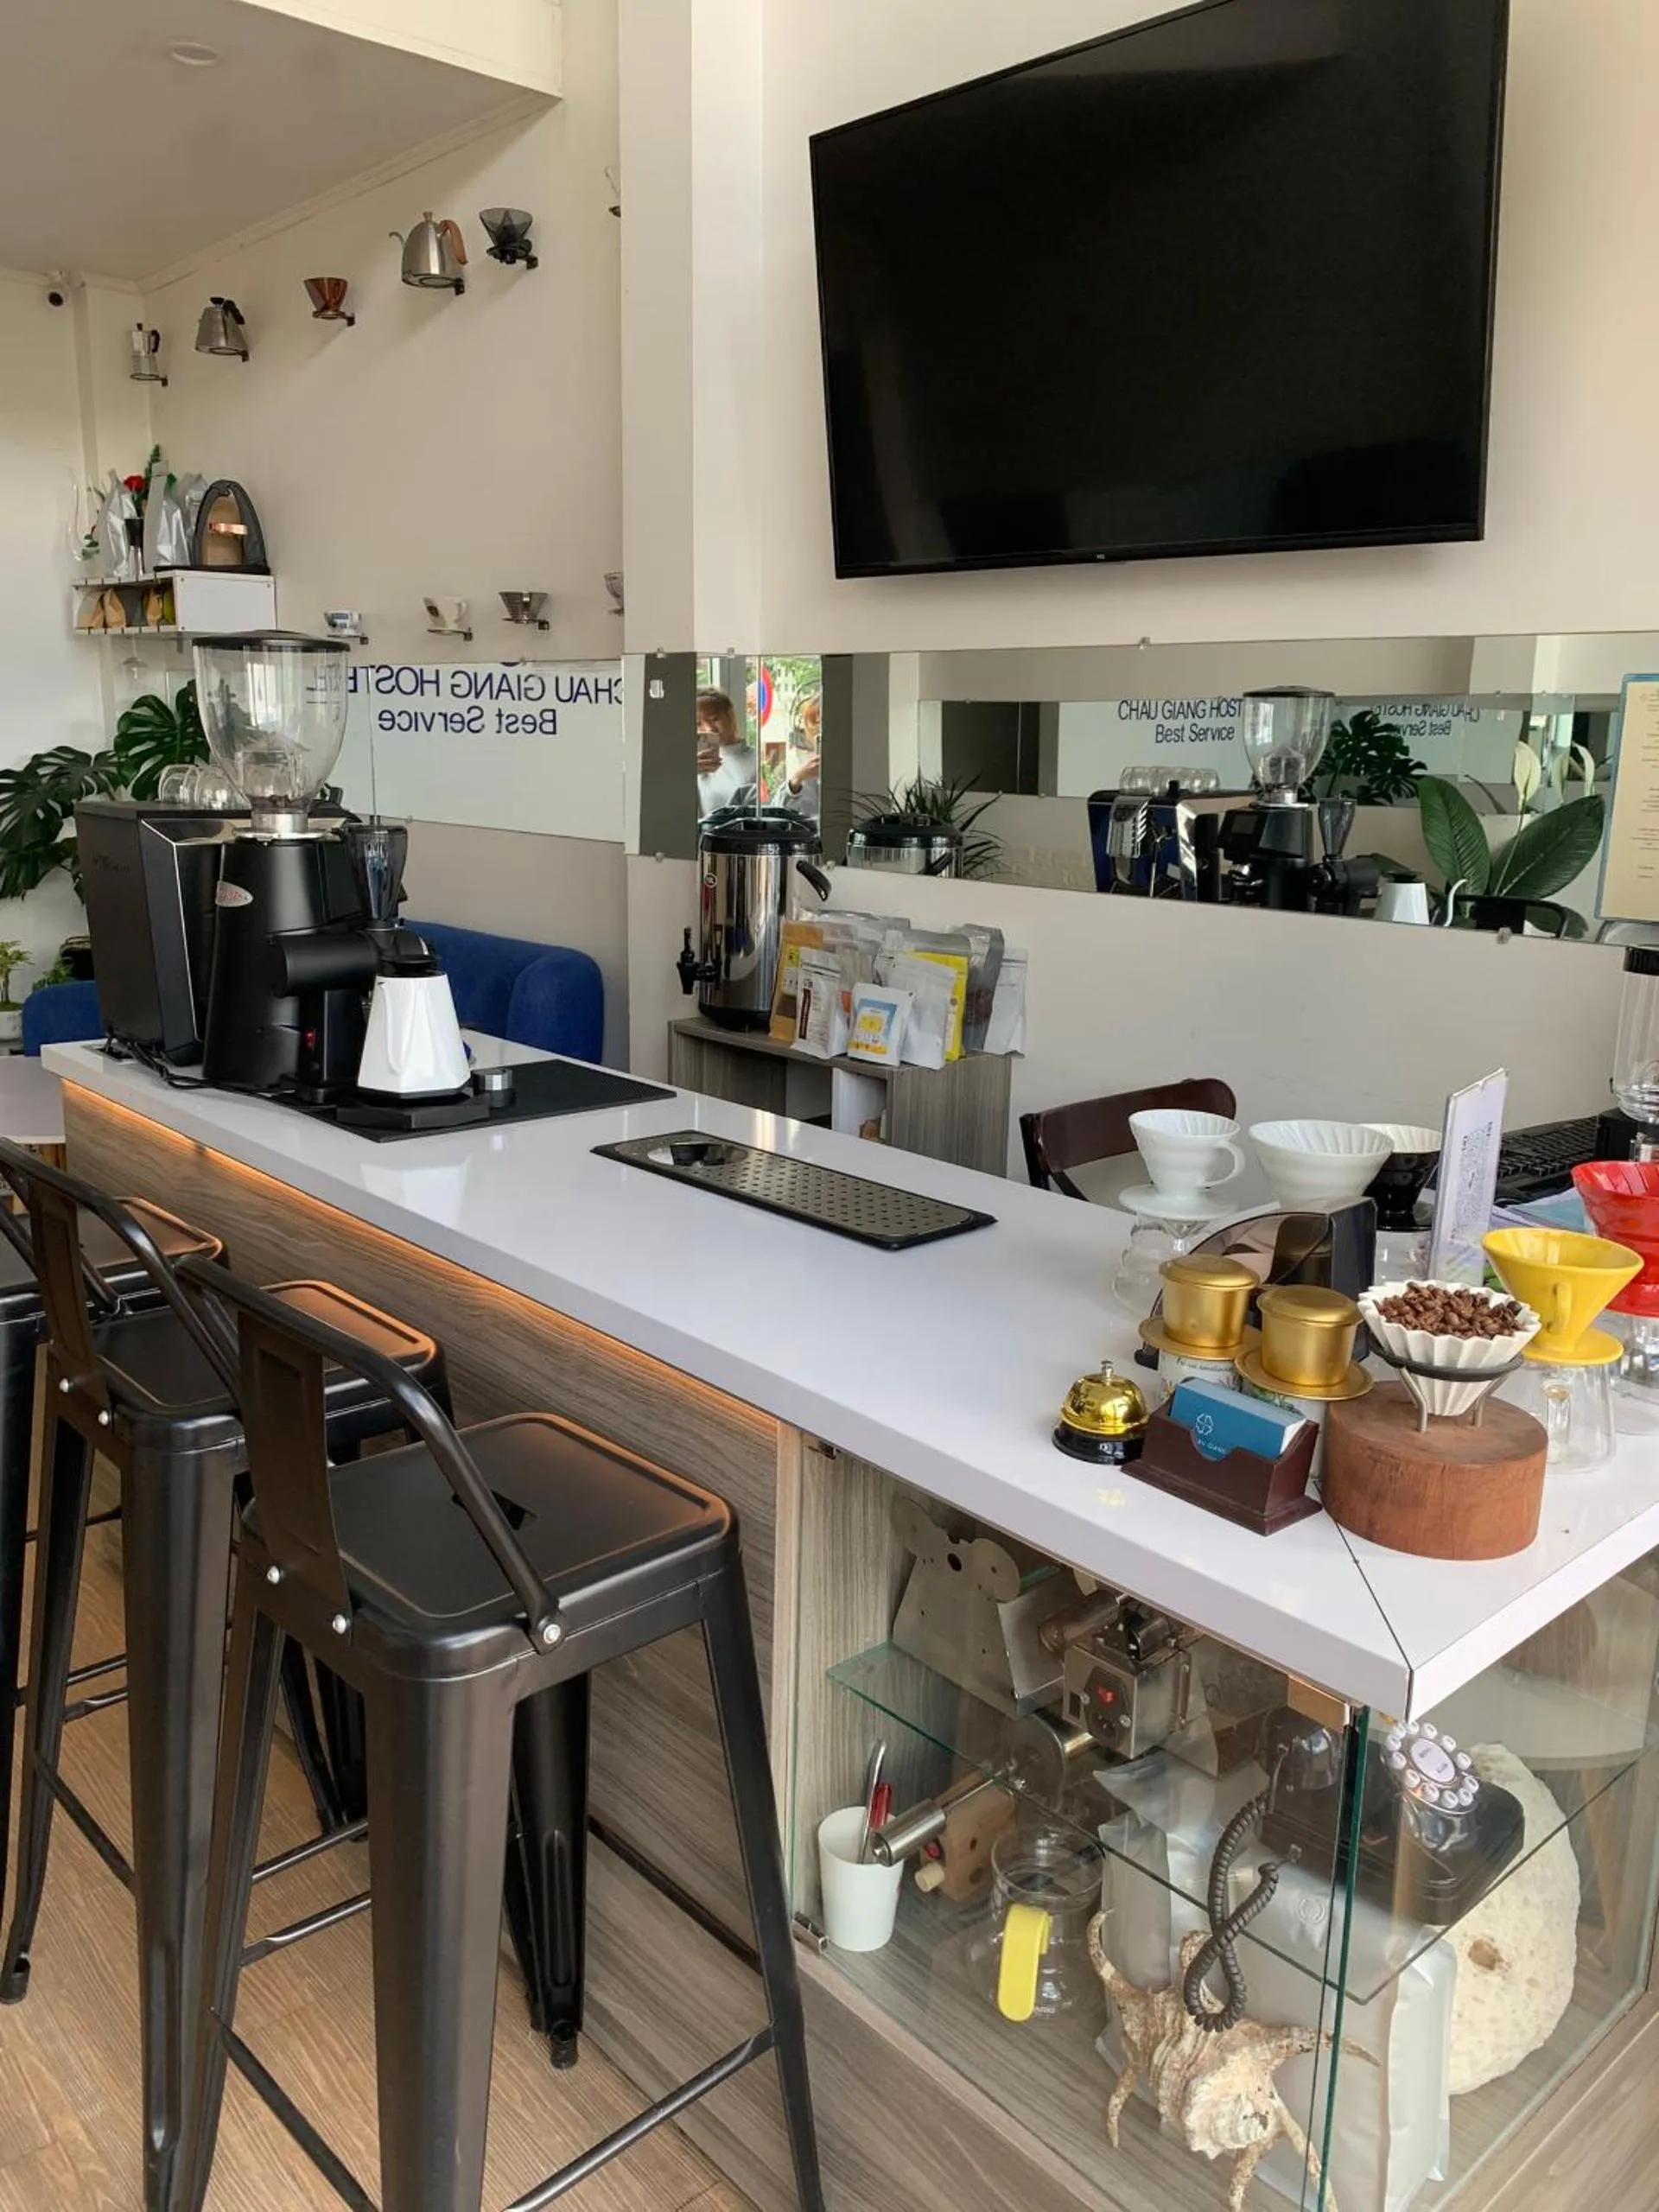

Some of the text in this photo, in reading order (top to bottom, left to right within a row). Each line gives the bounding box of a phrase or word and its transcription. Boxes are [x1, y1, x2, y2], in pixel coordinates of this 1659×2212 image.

[1117, 698, 1244, 720] CHAU GIANG HOST
[1155, 723, 1235, 743] Best Service
